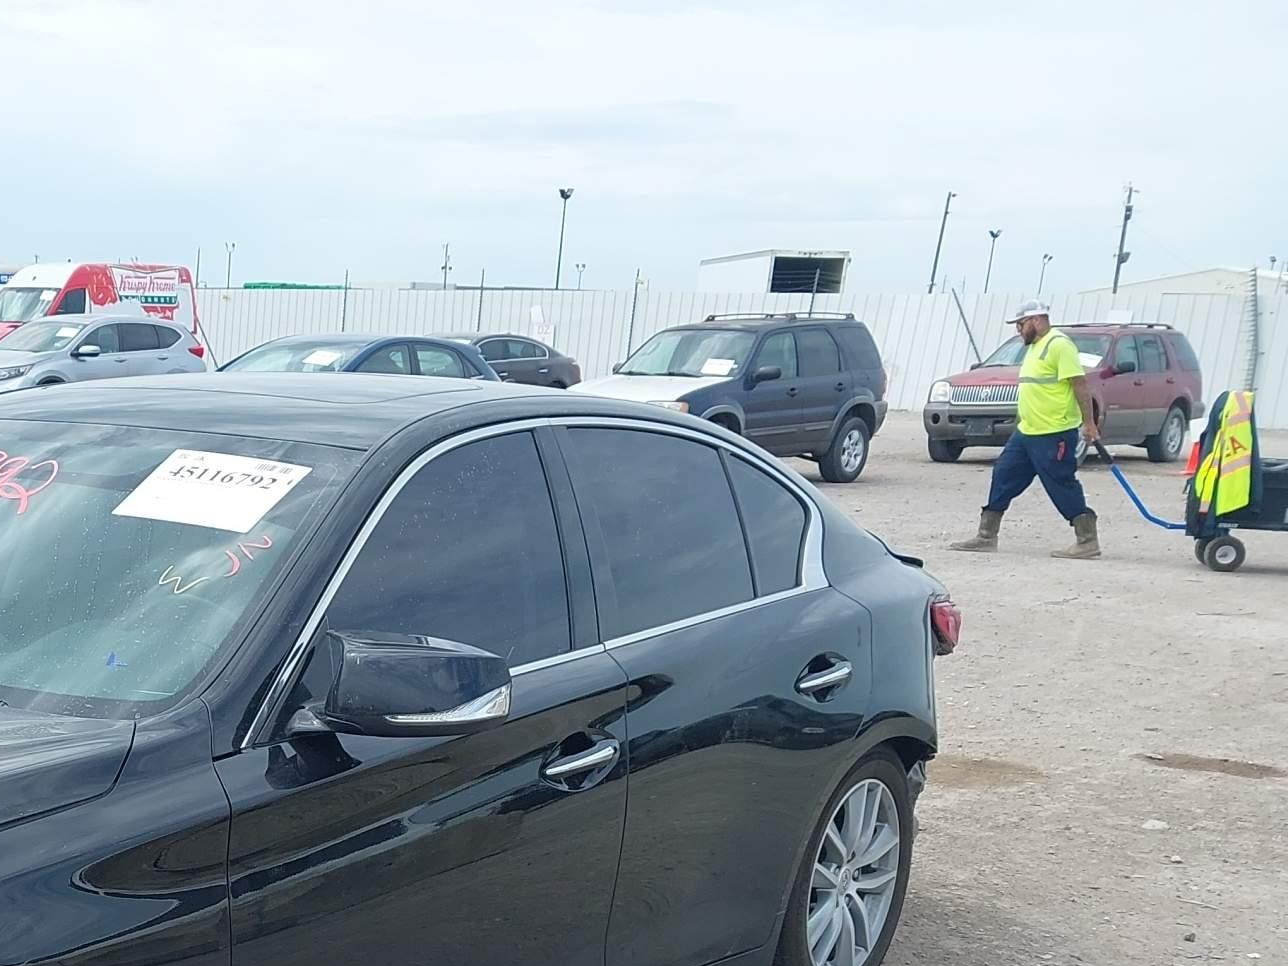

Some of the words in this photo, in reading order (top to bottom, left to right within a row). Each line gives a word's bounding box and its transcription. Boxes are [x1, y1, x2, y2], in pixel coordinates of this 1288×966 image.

[118, 274, 149, 294] Krispy
[148, 275, 176, 293] Kreme
[169, 464, 278, 490] 45116792
